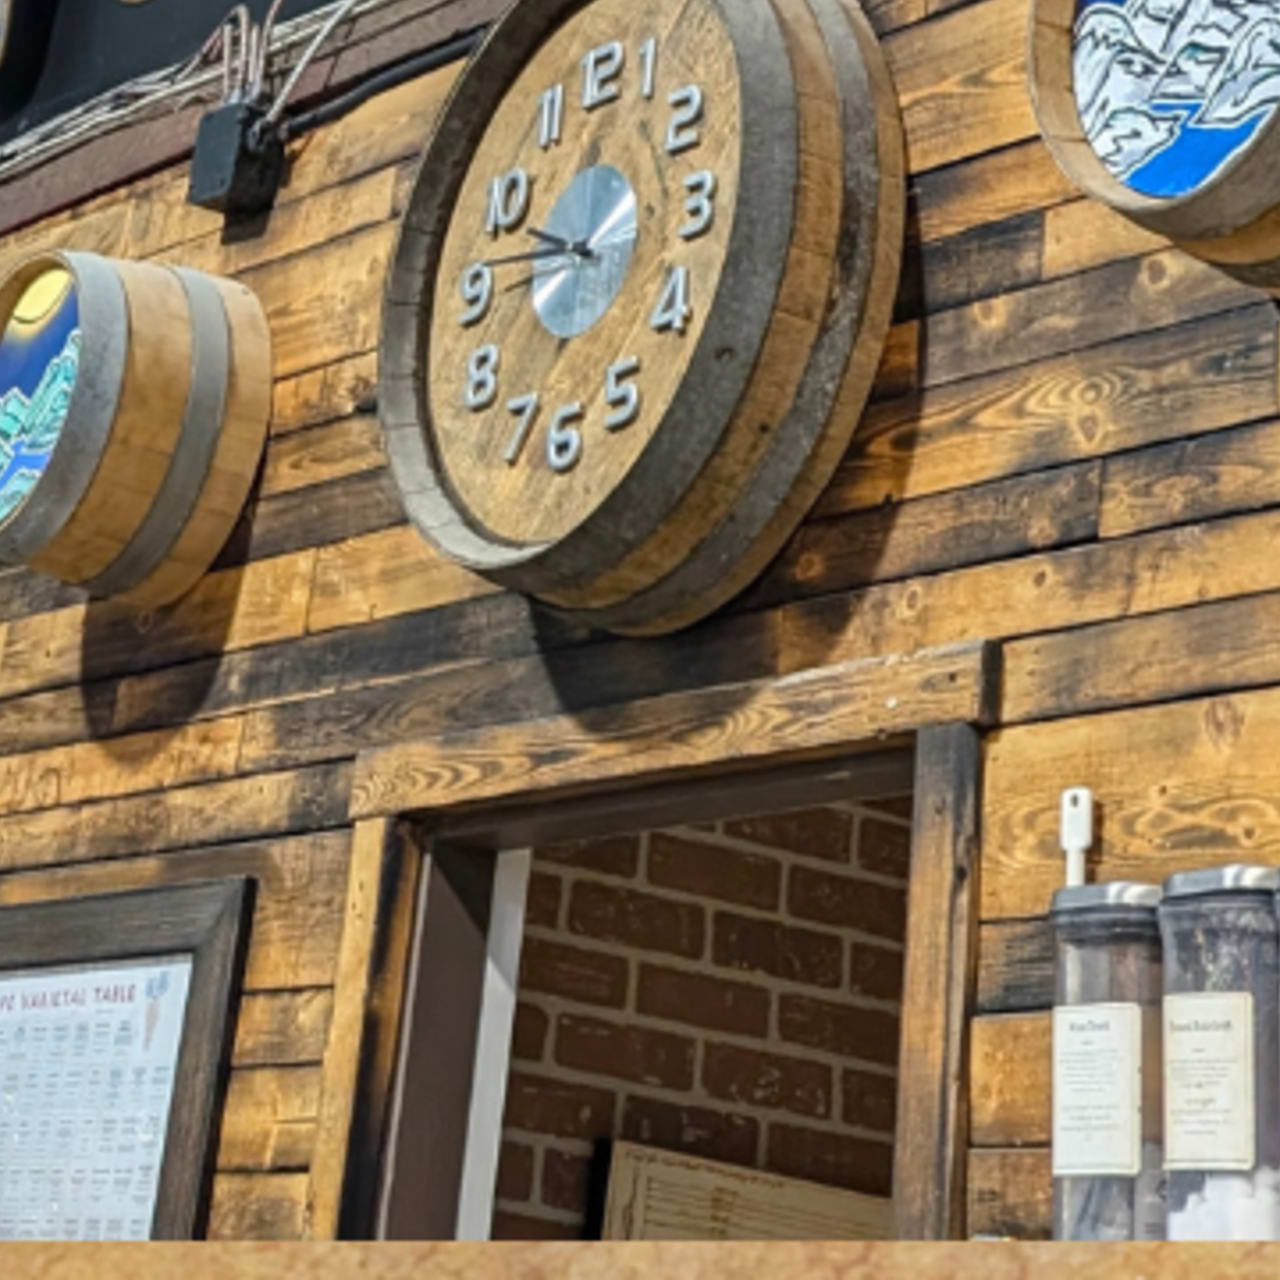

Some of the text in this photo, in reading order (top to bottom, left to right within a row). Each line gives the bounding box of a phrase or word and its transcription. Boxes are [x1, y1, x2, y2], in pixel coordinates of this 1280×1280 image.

[581, 41, 624, 111] 12
[638, 38, 658, 99] 1
[538, 84, 565, 149] 11
[665, 84, 704, 154] 2
[486, 168, 531, 236] 10
[679, 169, 718, 241] 3
[458, 263, 494, 327] 9
[650, 266, 692, 335] 4
[466, 344, 502, 412] 8
[604, 356, 640, 431] 5
[504, 393, 539, 463] 7
[545, 401, 583, 471] 6
[94, 983, 137, 1004] TABLE
